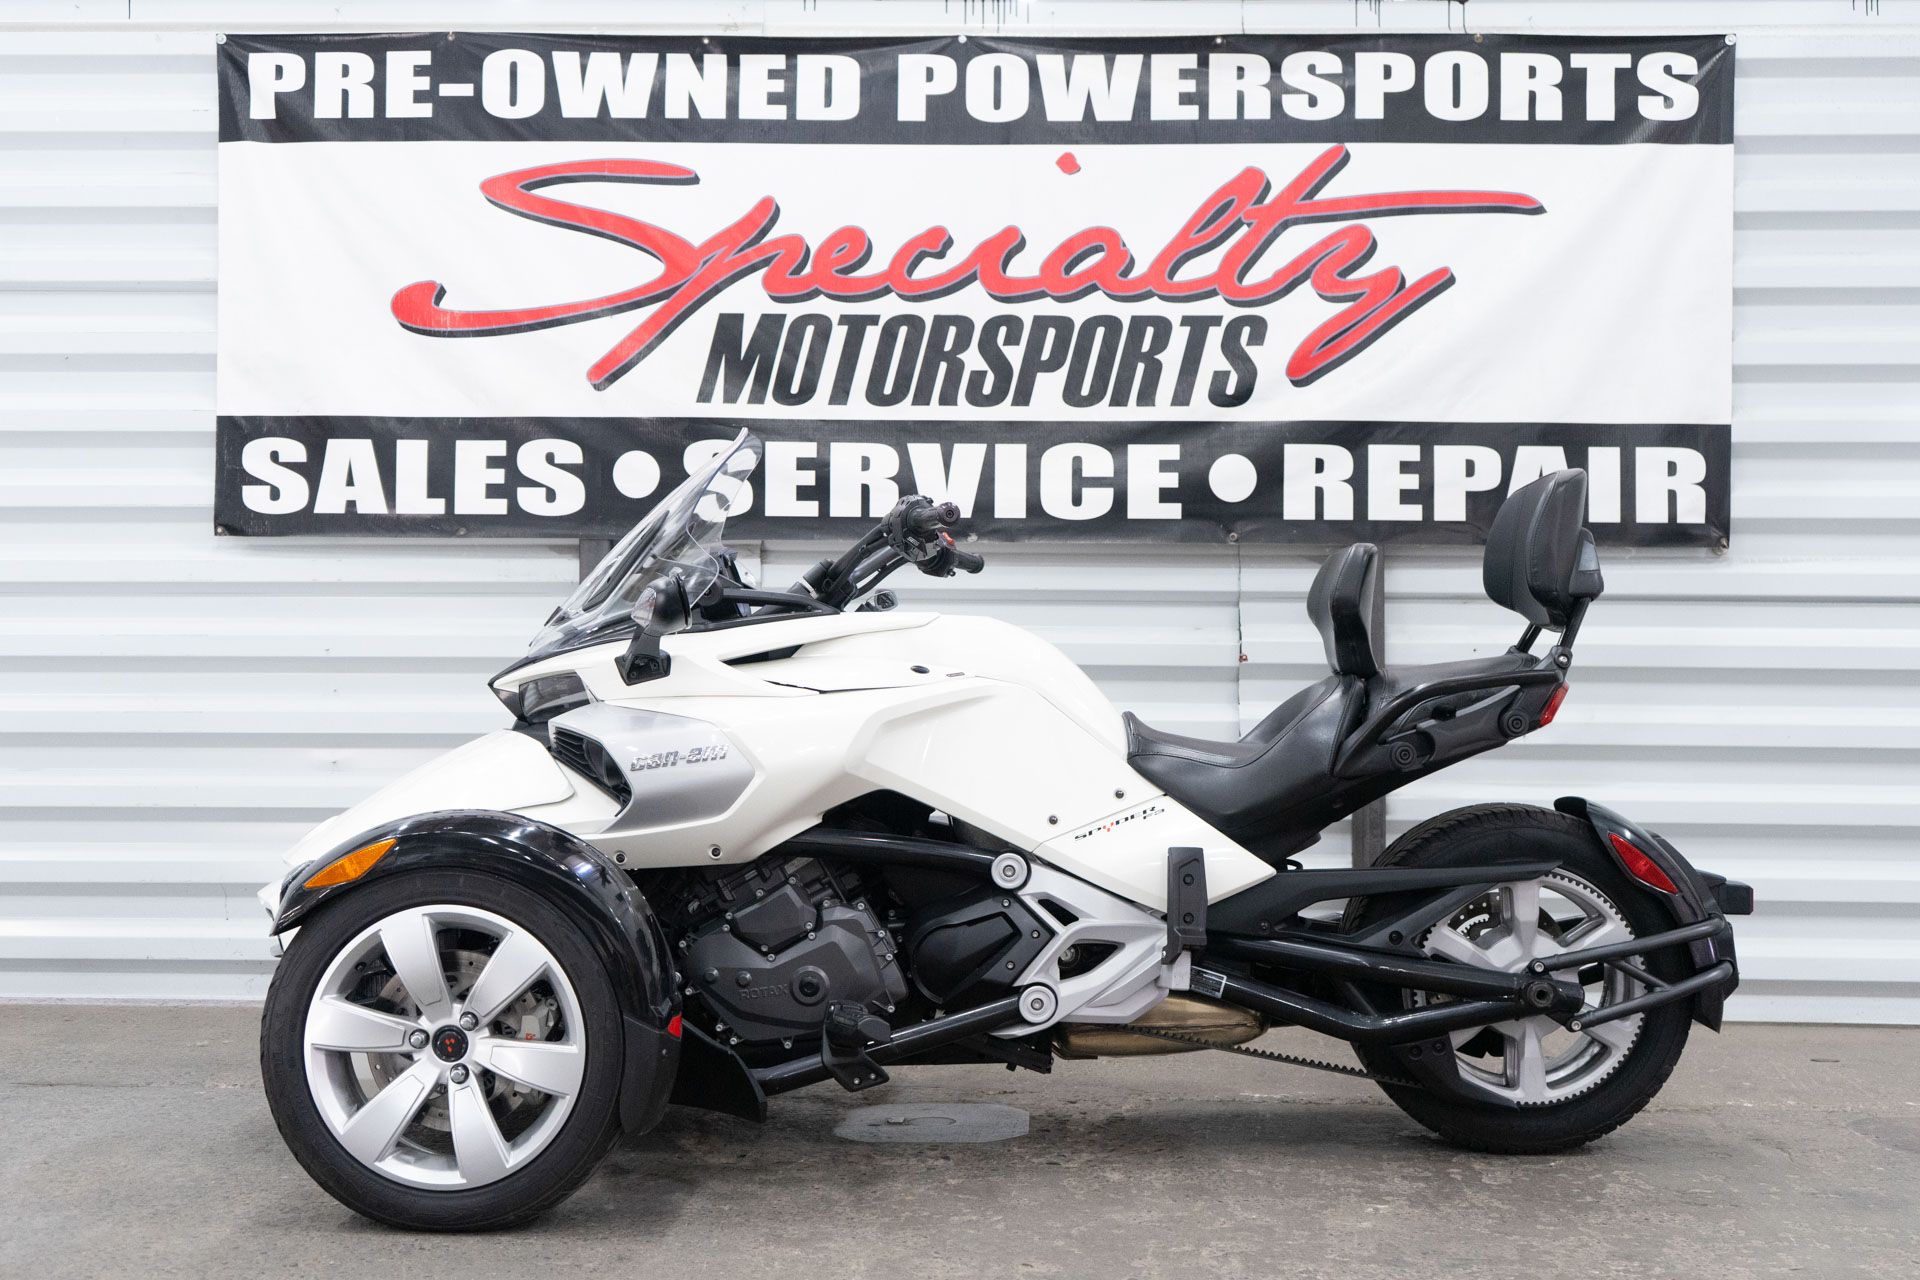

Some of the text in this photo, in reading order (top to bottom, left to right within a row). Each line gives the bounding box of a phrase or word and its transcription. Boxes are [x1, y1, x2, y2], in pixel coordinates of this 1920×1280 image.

[248, 48, 1700, 122] PRE-OWNED POWERSPORTS
[390, 143, 1547, 391] Specialty
[696, 312, 1268, 409] MOTORSPORTS
[241, 436, 586, 518] SALES
[683, 438, 1183, 521] SERVICE
